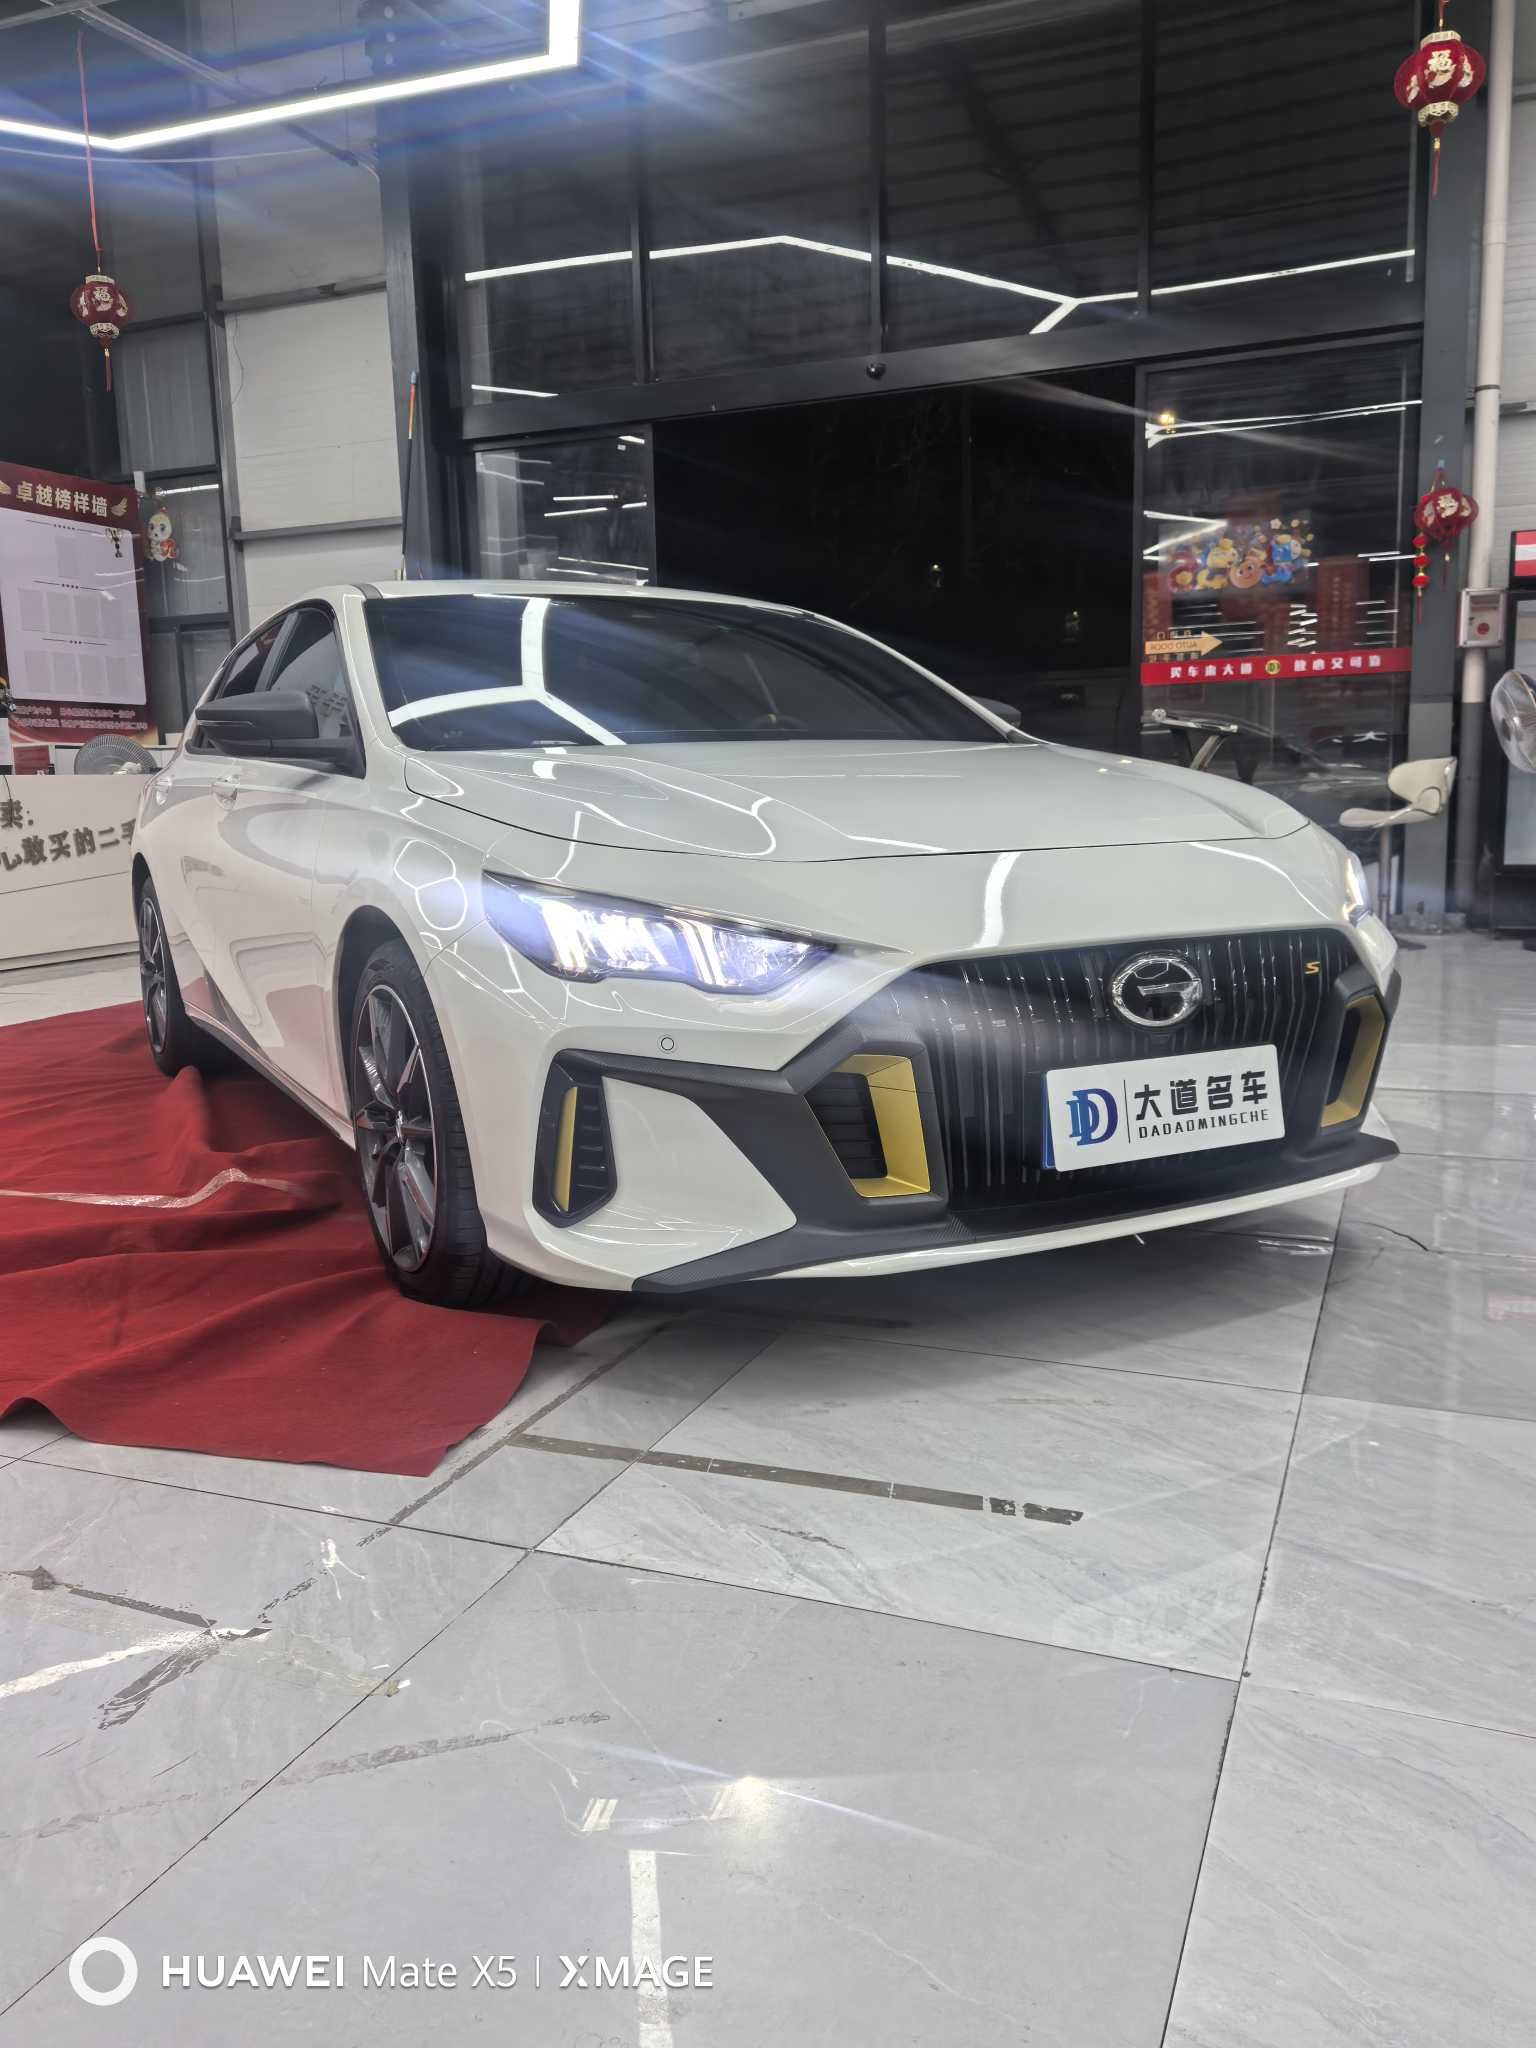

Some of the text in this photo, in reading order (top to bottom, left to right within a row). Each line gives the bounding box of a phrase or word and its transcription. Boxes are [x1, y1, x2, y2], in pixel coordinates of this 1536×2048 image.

[16, 480, 108, 518] 卓越榜样墙
[1304, 961, 1321, 975] S
[1133, 1070, 1269, 1121] 大道名车
[1138, 1109, 1269, 1139] DADAOMINGCHE
